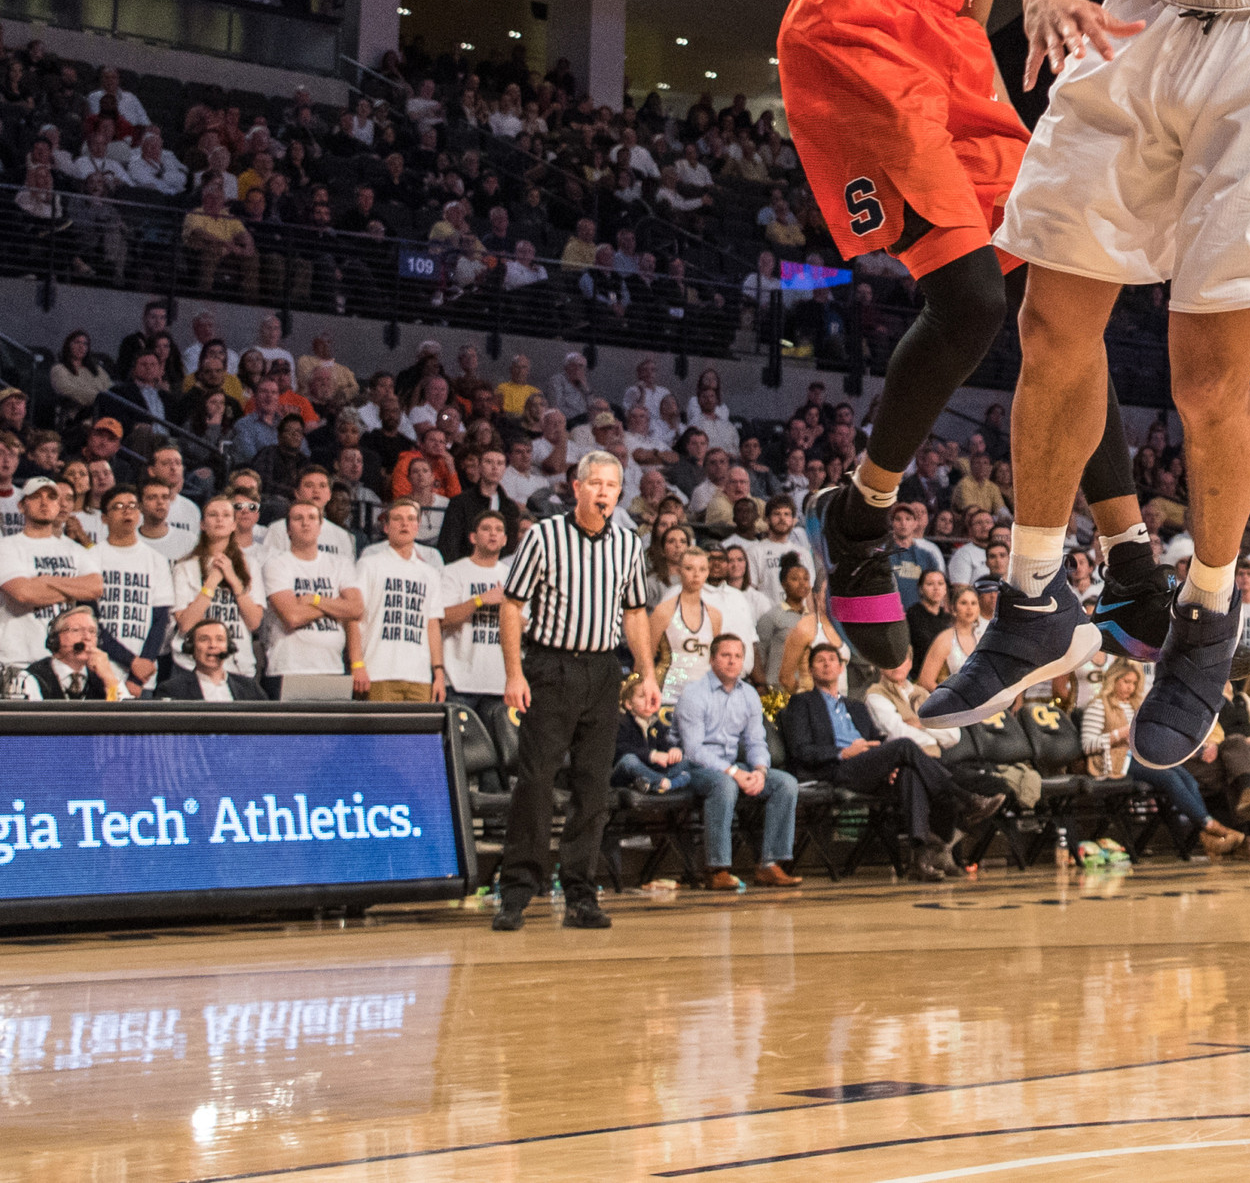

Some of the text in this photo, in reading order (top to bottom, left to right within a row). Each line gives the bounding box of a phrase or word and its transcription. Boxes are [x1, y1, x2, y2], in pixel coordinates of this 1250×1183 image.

[844, 176, 886, 238] S
[407, 257, 434, 275] 109
[102, 569, 150, 589] AIR BALL
[385, 577, 427, 598] AIR BALL
[101, 587, 149, 606] AIR BALL
[384, 593, 402, 609] AIR
[100, 605, 119, 621] AIR
[383, 610, 402, 625] AIR
[382, 626, 402, 641] AIR
[209, 791, 423, 844] Athletics.
